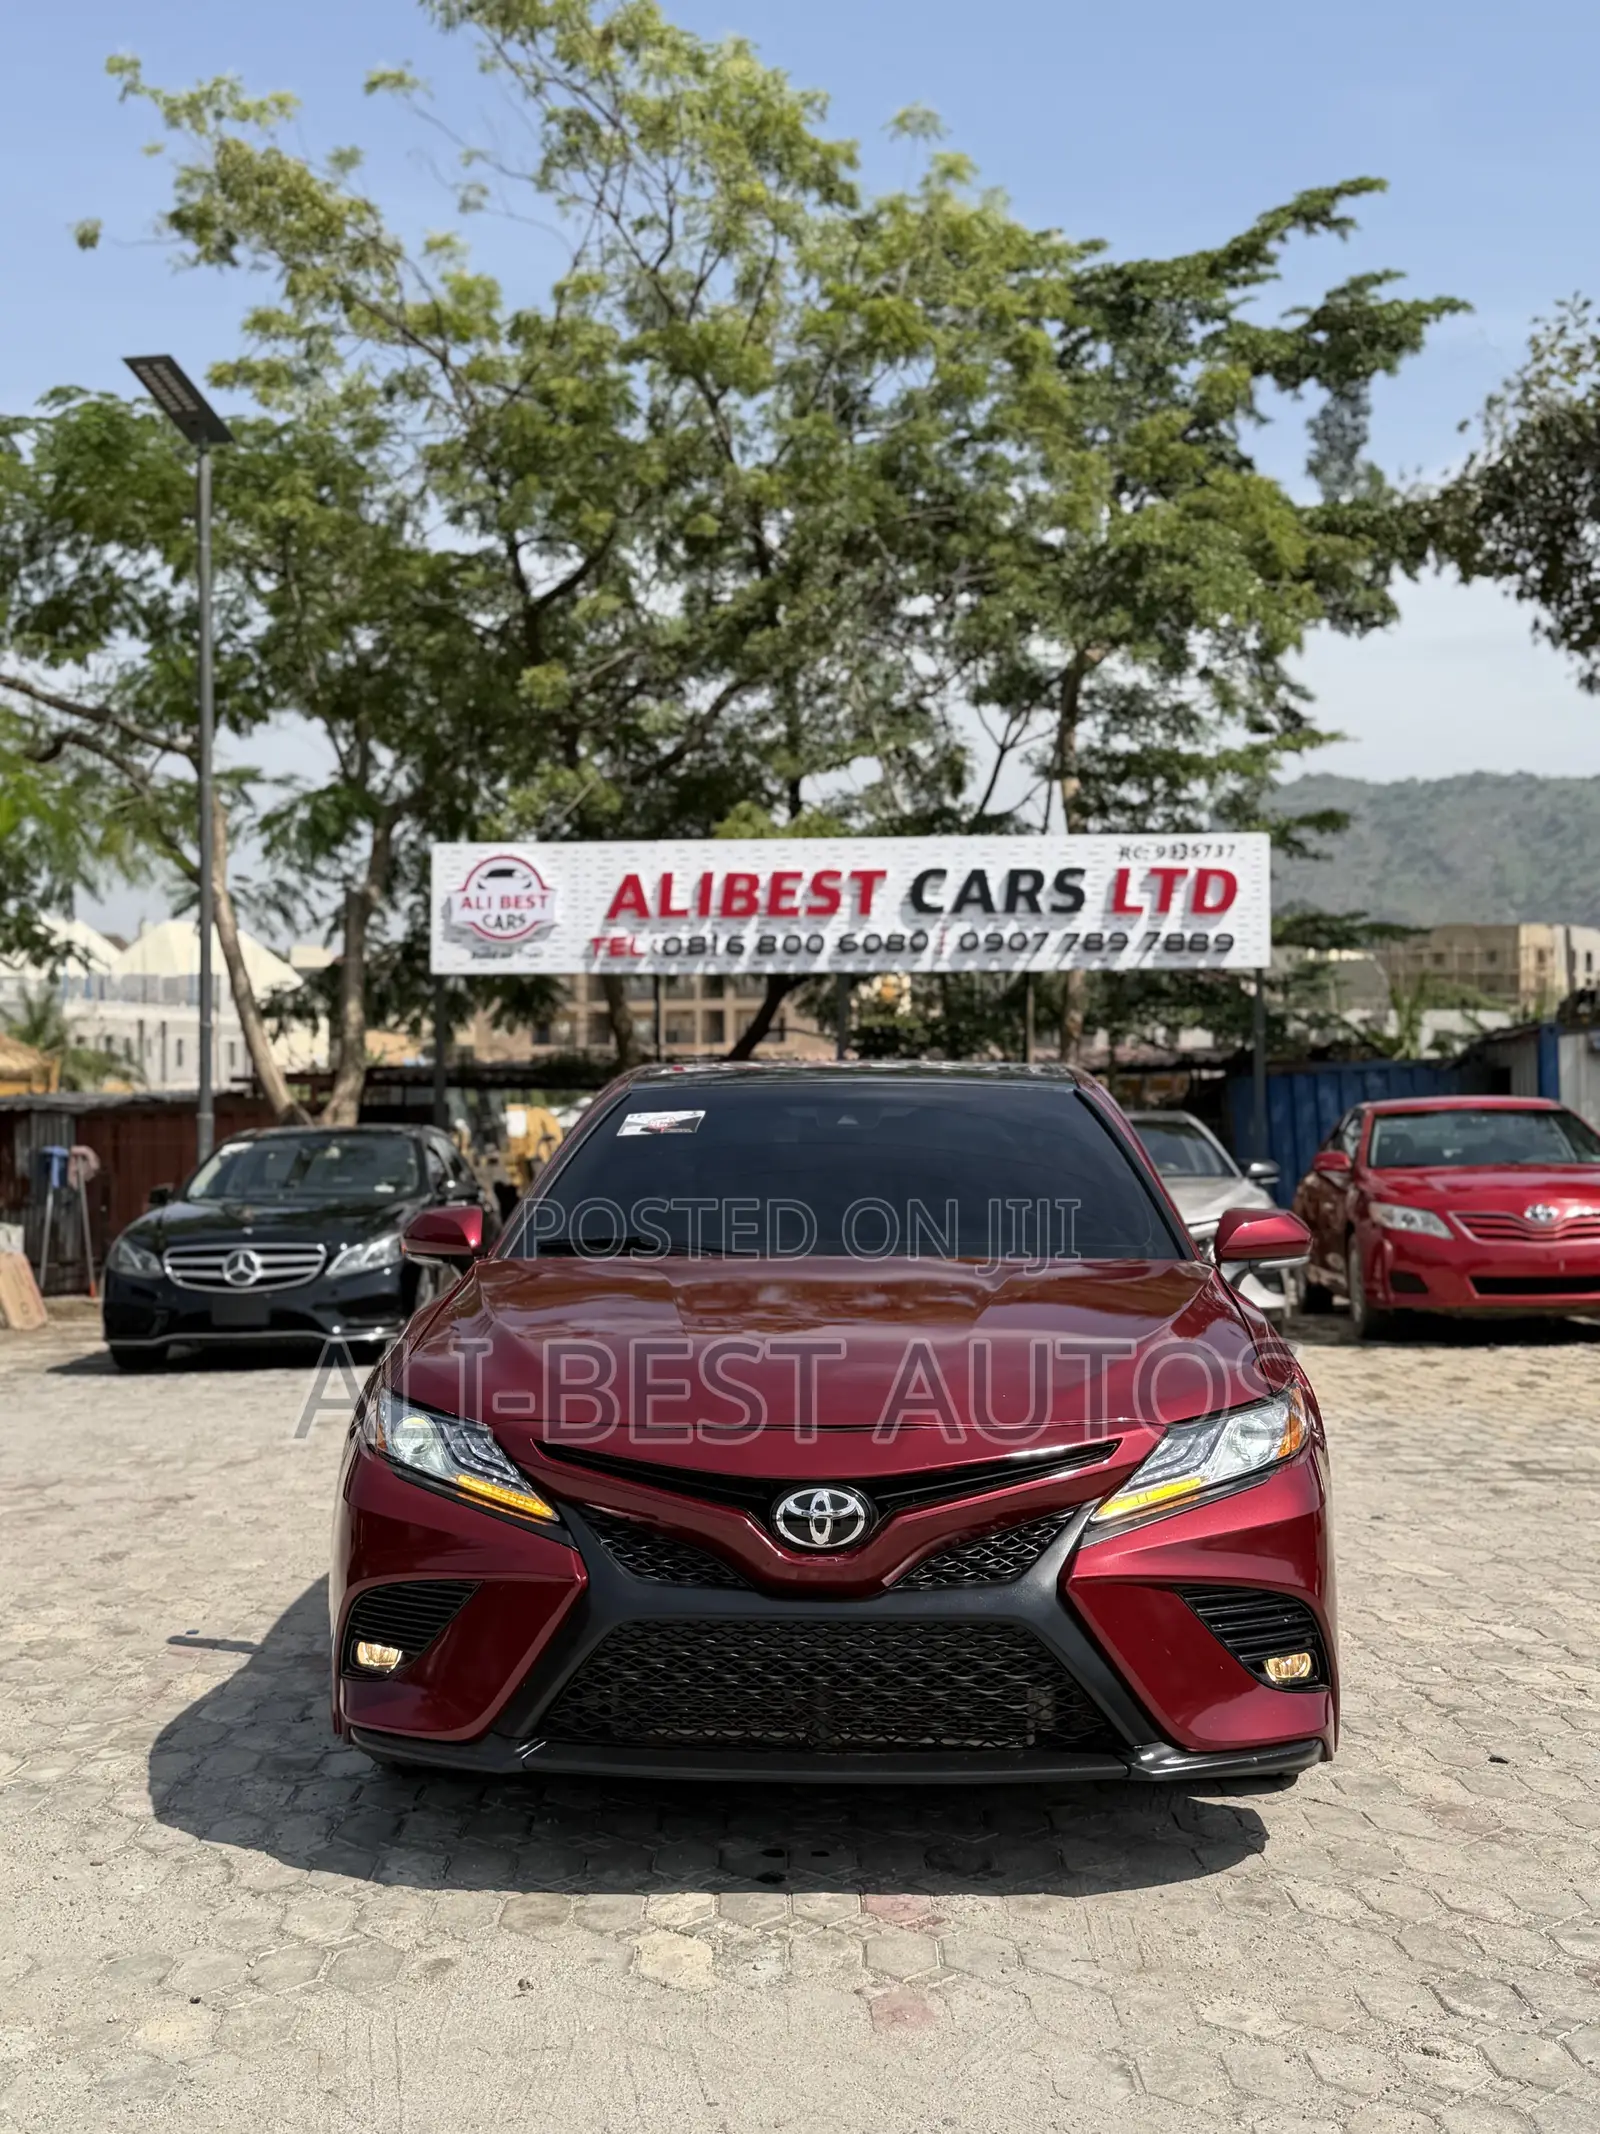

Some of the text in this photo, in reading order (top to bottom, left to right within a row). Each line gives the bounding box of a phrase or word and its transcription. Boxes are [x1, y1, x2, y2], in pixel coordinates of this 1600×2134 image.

[462, 895, 547, 909] ALI BEST
[605, 867, 1239, 920] ALIBEST CARS LTD
[482, 913, 527, 931] CARS
[662, 932, 745, 957] 0816
[757, 933, 825, 955] 800
[838, 930, 929, 953] 6080
[959, 931, 1049, 952] 0907
[1058, 932, 1129, 954] 789
[1143, 931, 1234, 953] 7889
